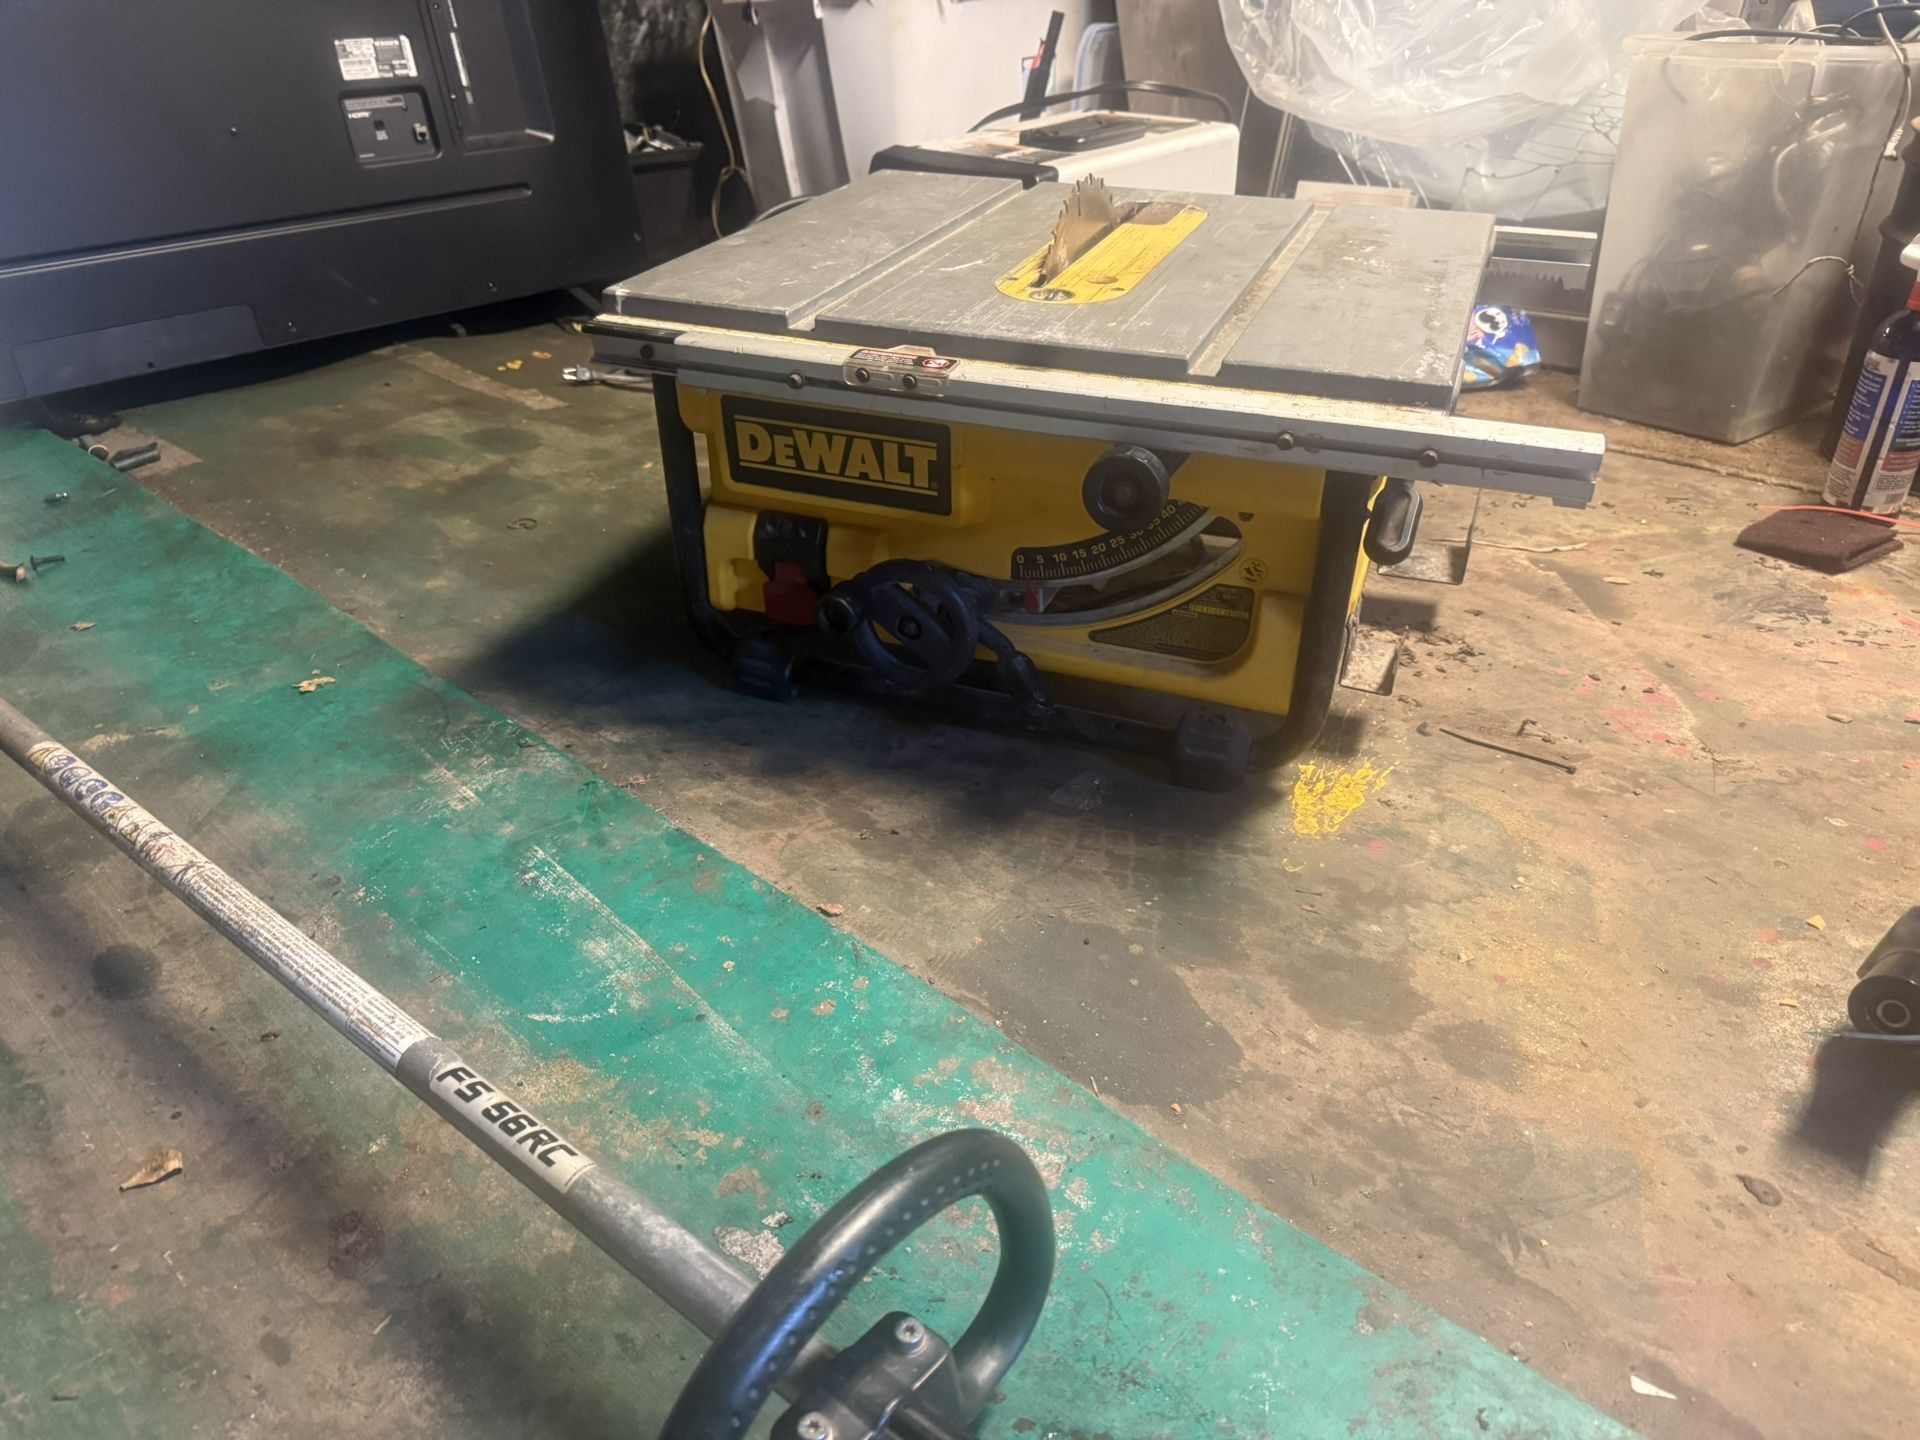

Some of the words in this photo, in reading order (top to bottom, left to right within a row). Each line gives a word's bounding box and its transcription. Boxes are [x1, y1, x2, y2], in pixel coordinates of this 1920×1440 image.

[1016, 554, 1025, 564] 0
[1036, 554, 1044, 564] 5
[1052, 552, 1067, 563] 10
[1072, 549, 1087, 560] 15
[1091, 543, 1106, 555] 20
[1109, 536, 1125, 548] 25
[1161, 505, 1176, 520] 40
[436, 1066, 496, 1103] FS
[481, 1101, 580, 1168] 56RC
